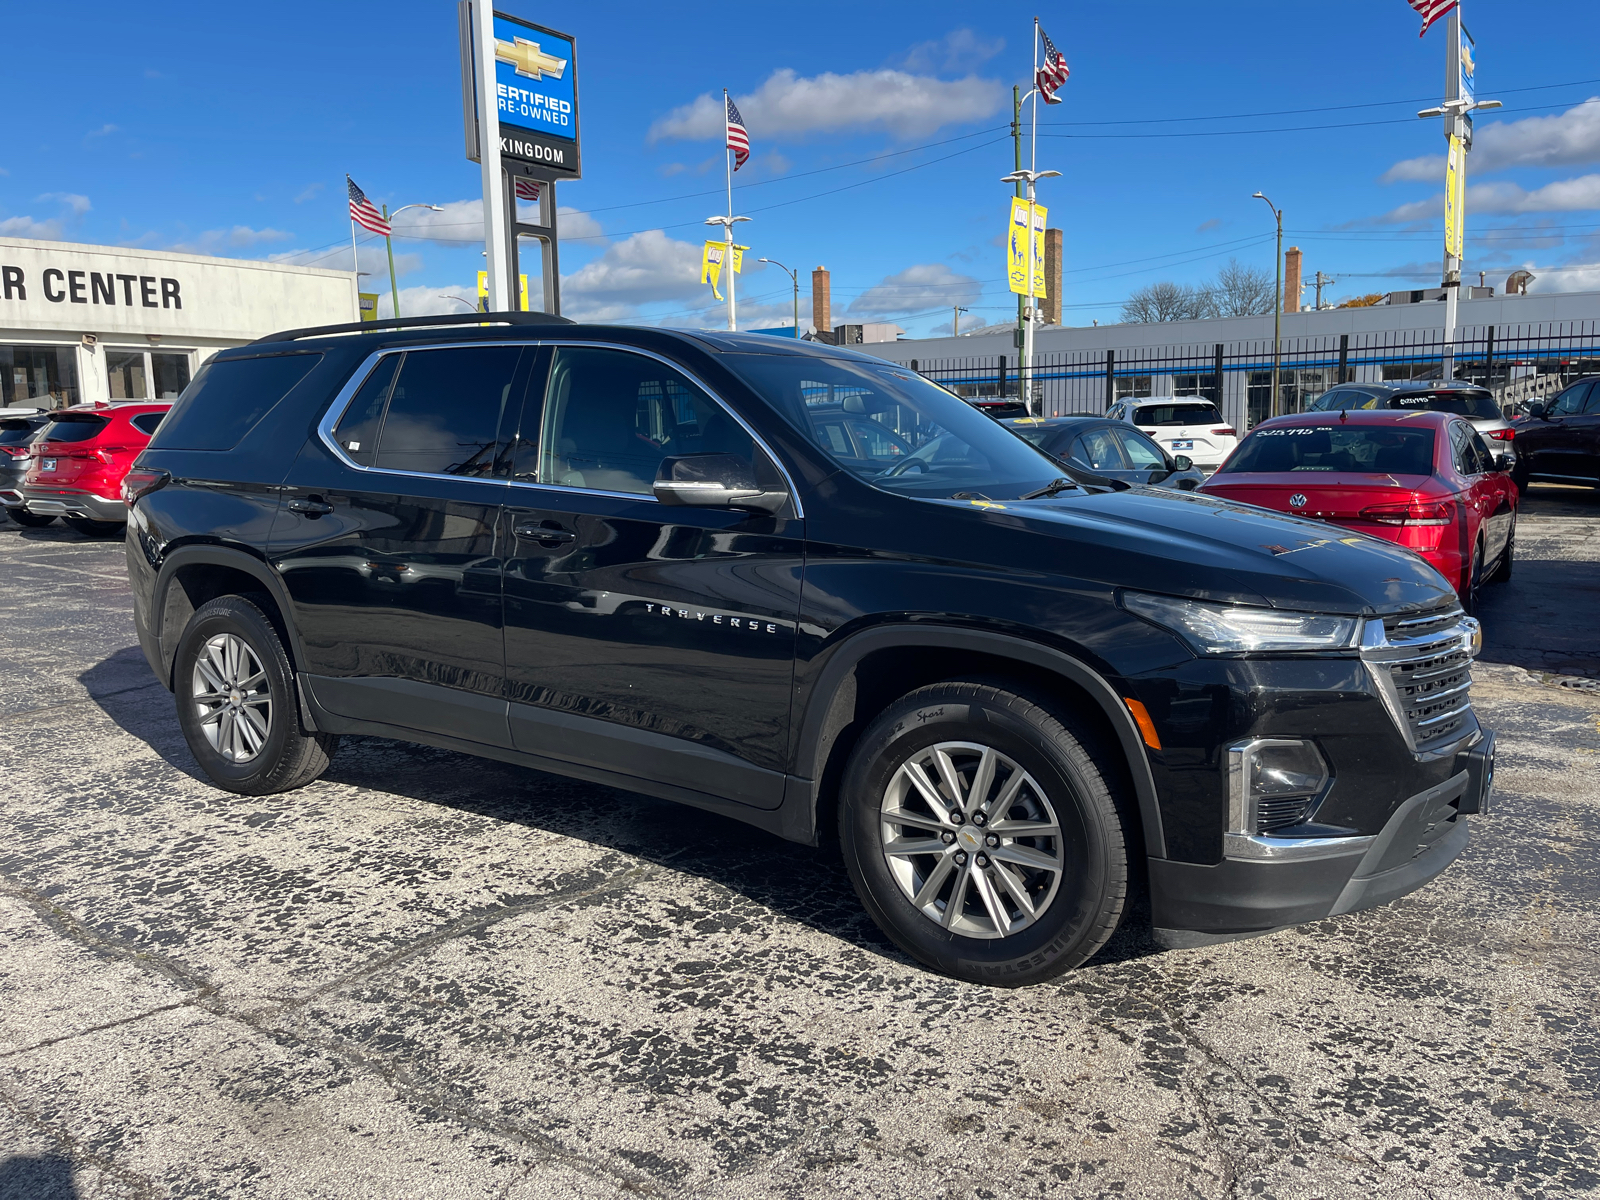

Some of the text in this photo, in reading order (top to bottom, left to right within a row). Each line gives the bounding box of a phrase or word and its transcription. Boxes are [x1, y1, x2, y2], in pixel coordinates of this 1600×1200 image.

[497, 83, 571, 113] ERTIFIED
[498, 98, 569, 126] RE-OWNED
[499, 137, 564, 163] KINGDOM
[0, 265, 183, 309] R CENTER
[646, 603, 776, 634] TRAVERSE
[916, 707, 945, 723] Sport
[966, 922, 1077, 976] MILESTAR
